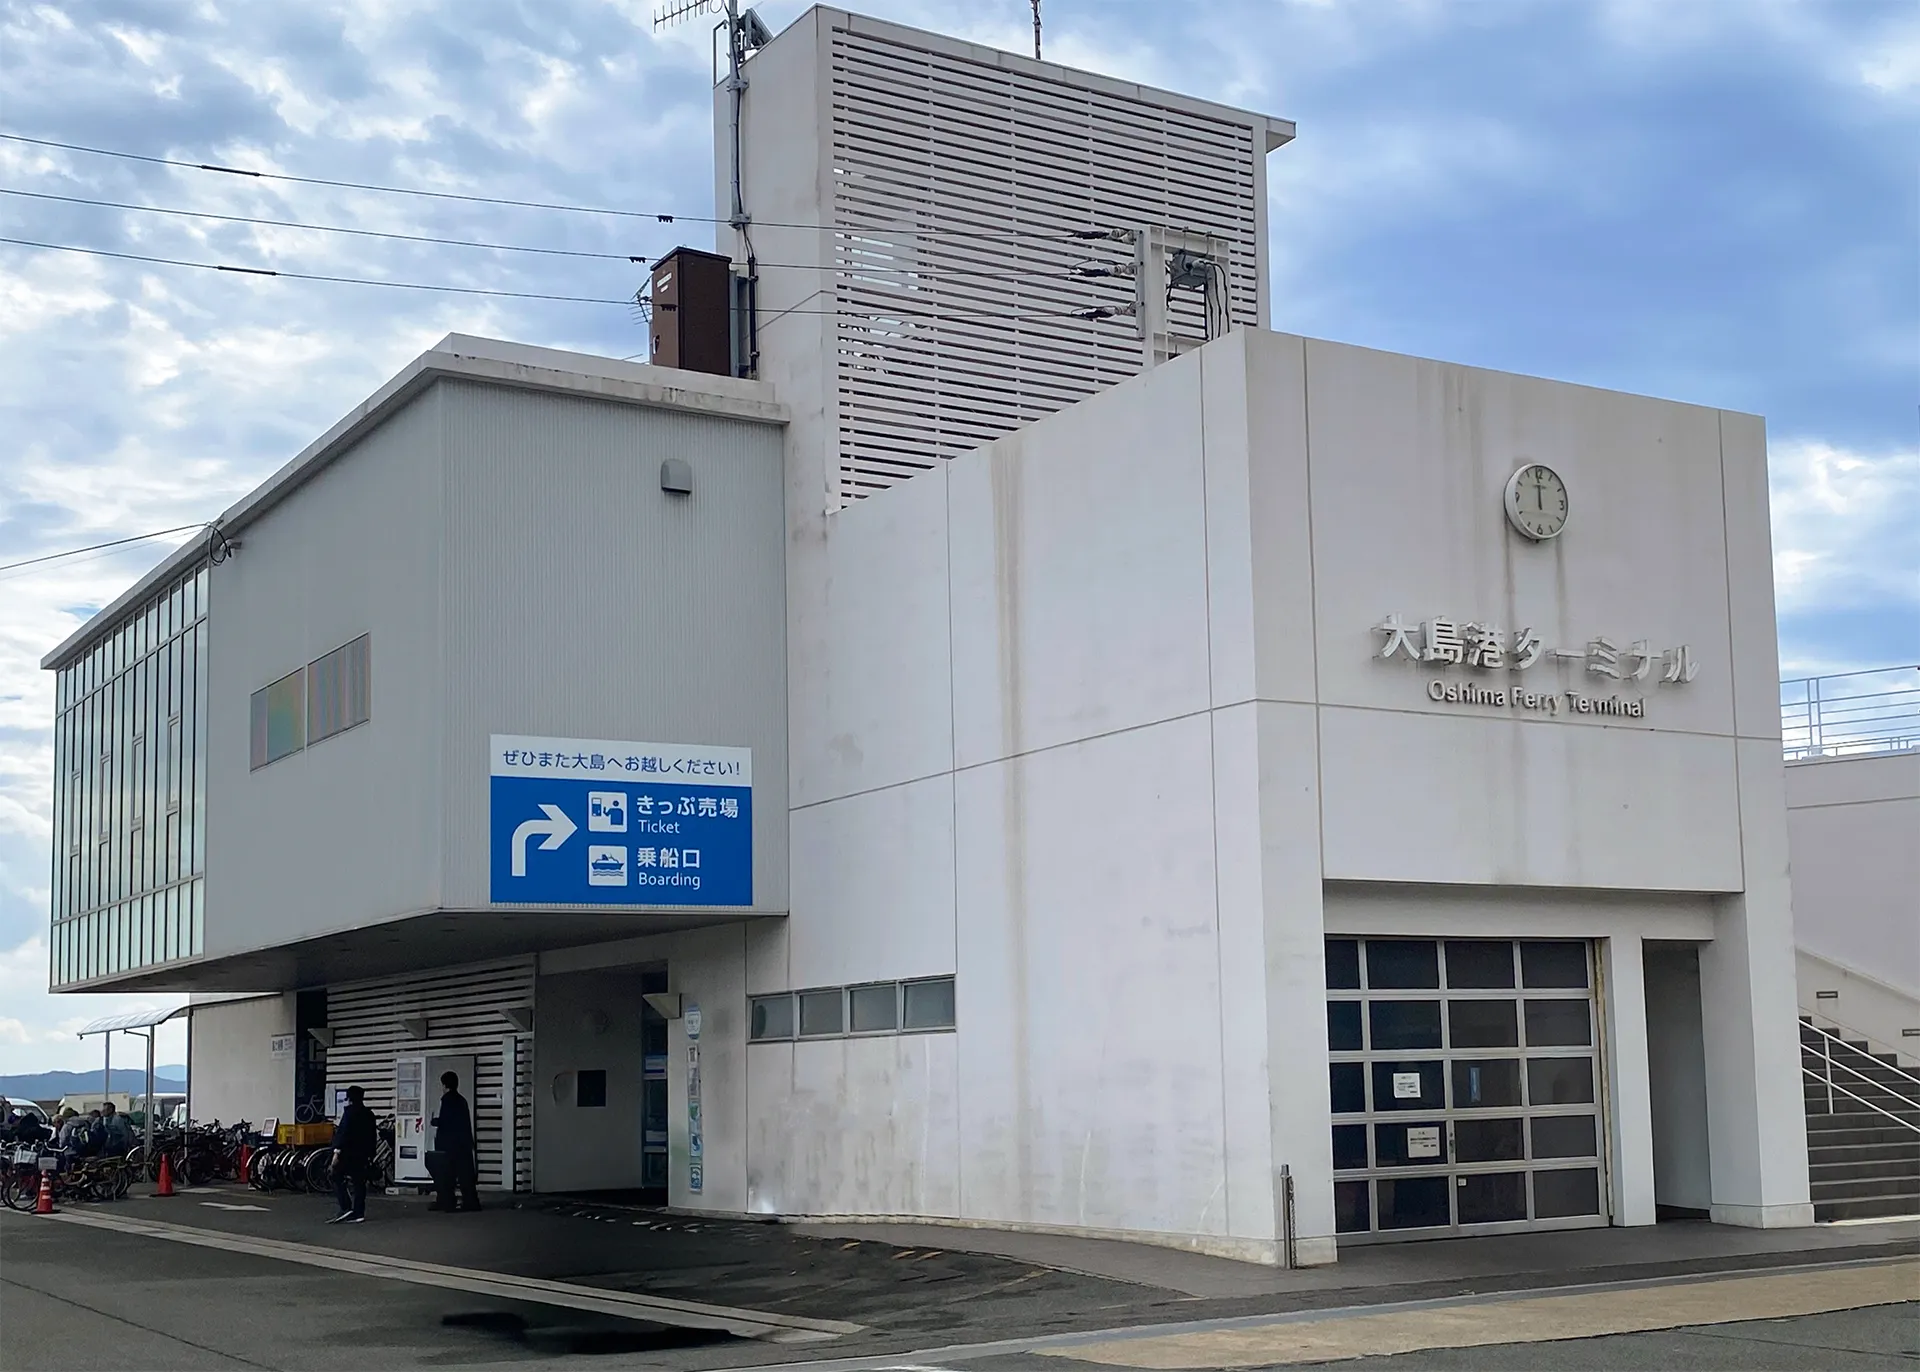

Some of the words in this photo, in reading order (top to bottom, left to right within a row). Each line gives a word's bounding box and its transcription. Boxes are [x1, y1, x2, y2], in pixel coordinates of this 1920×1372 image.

[1535, 467, 1543, 480] 12
[1559, 499, 1565, 511] 3
[1537, 524, 1543, 535] 6
[1374, 614, 1699, 684] 大島港ターミナル
[1427, 679, 1505, 707] Oshima
[1510, 686, 1562, 716] Ferry
[1565, 690, 1645, 718] Terminal
[503, 750, 740, 776] ぜひまた大島へお越しください!
[636, 795, 739, 819] きっぷ売場
[638, 819, 680, 834] Ticket
[637, 847, 701, 869] 乗船口
[638, 872, 701, 890] Boarding
